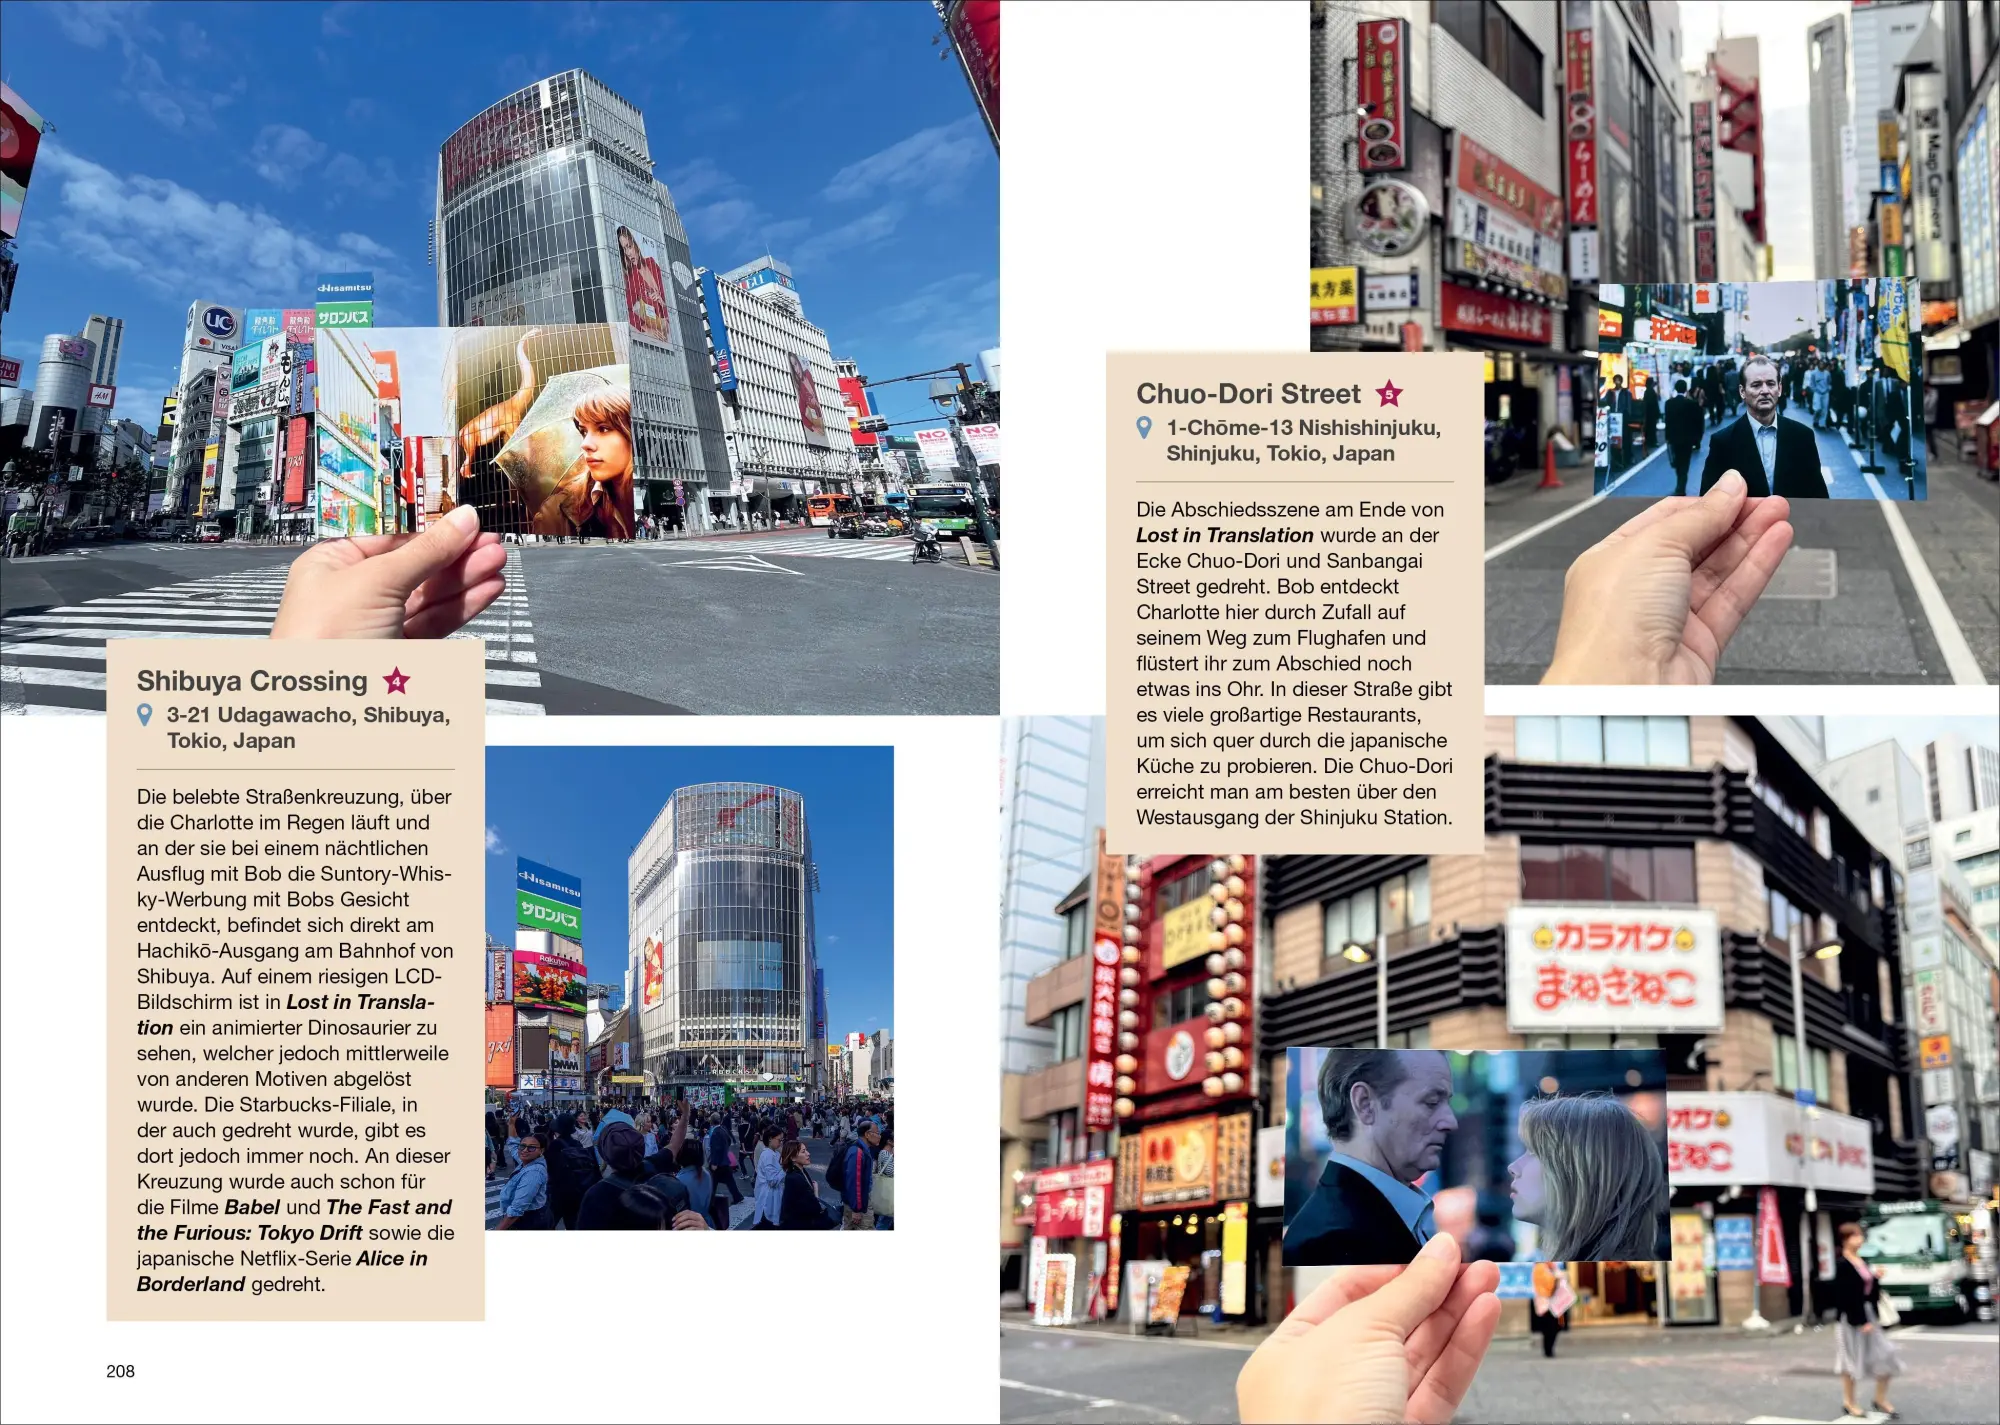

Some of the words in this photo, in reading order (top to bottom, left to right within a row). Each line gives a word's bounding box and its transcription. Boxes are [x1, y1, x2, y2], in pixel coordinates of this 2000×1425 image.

[1926, 133, 1942, 173] Map
[1574, 142, 1594, 221] らーめん
[1927, 173, 1943, 240] Camera
[318, 284, 372, 292] Hisamitsu
[205, 312, 235, 332] UC
[318, 311, 369, 325] サロンパス
[278, 352, 292, 405] もんじゃ
[715, 349, 732, 384] SEIBU
[94, 392, 109, 401] H&M
[918, 430, 946, 439] NO
[966, 426, 996, 434] NO
[518, 870, 581, 898] Hisamitsu
[521, 901, 578, 929] サロンパス
[1555, 921, 1674, 952] カラオケ
[539, 954, 570, 968] Rakuten
[1534, 961, 1697, 1011] まねきねこ
[488, 1035, 513, 1064] クスリ
[552, 1059, 579, 1070] DMM
